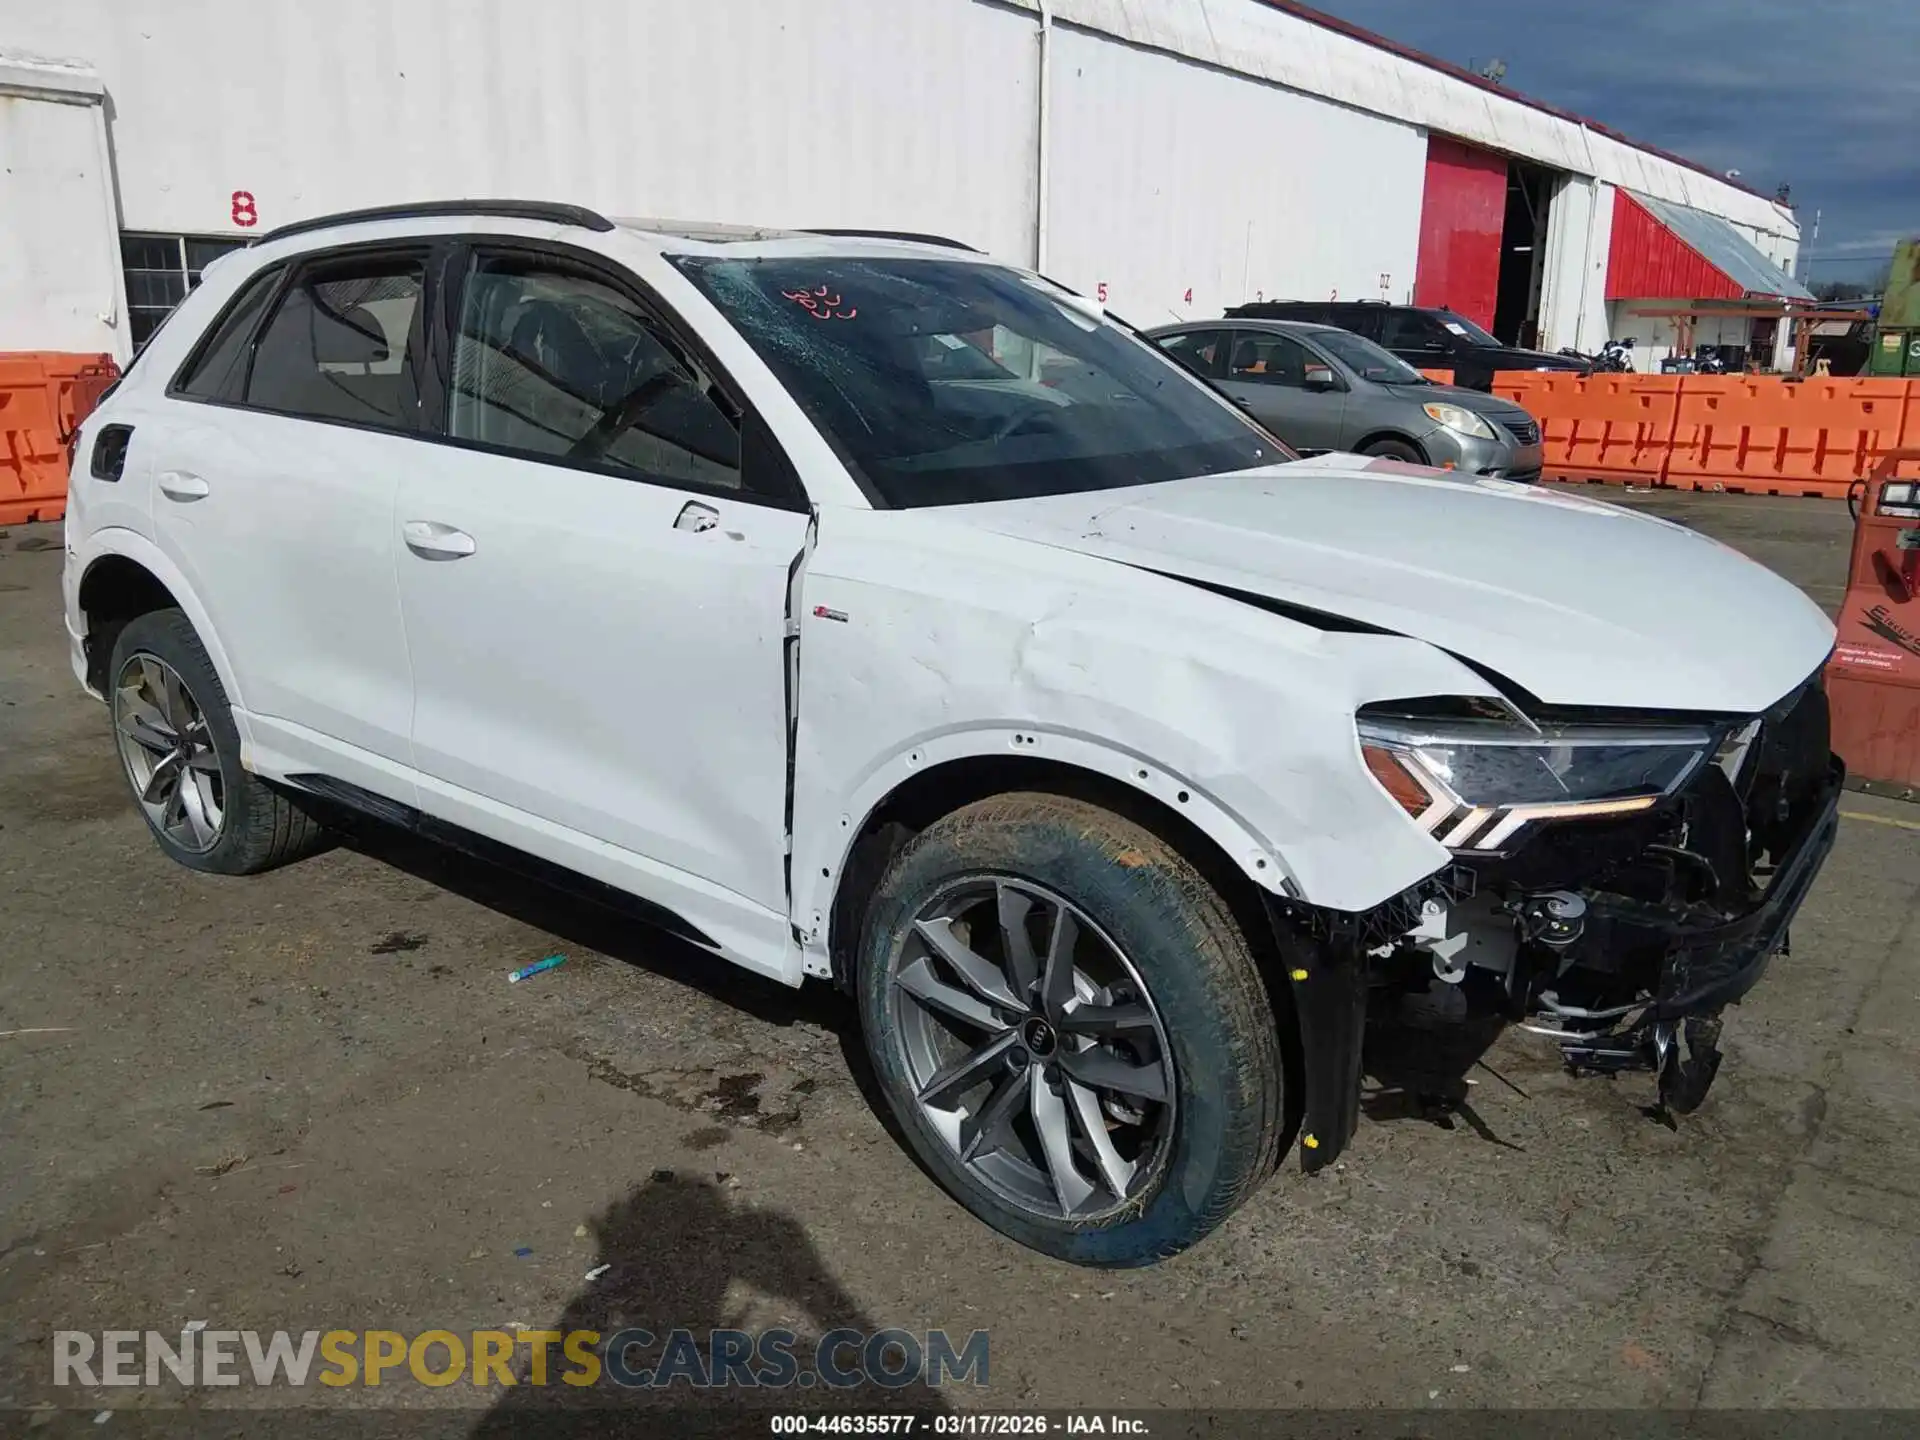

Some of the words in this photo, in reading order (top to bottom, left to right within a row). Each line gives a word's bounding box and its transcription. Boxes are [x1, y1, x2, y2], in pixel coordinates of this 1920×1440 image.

[231, 190, 258, 227] 8
[1097, 283, 1107, 302] 5
[1184, 288, 1192, 306] 4
